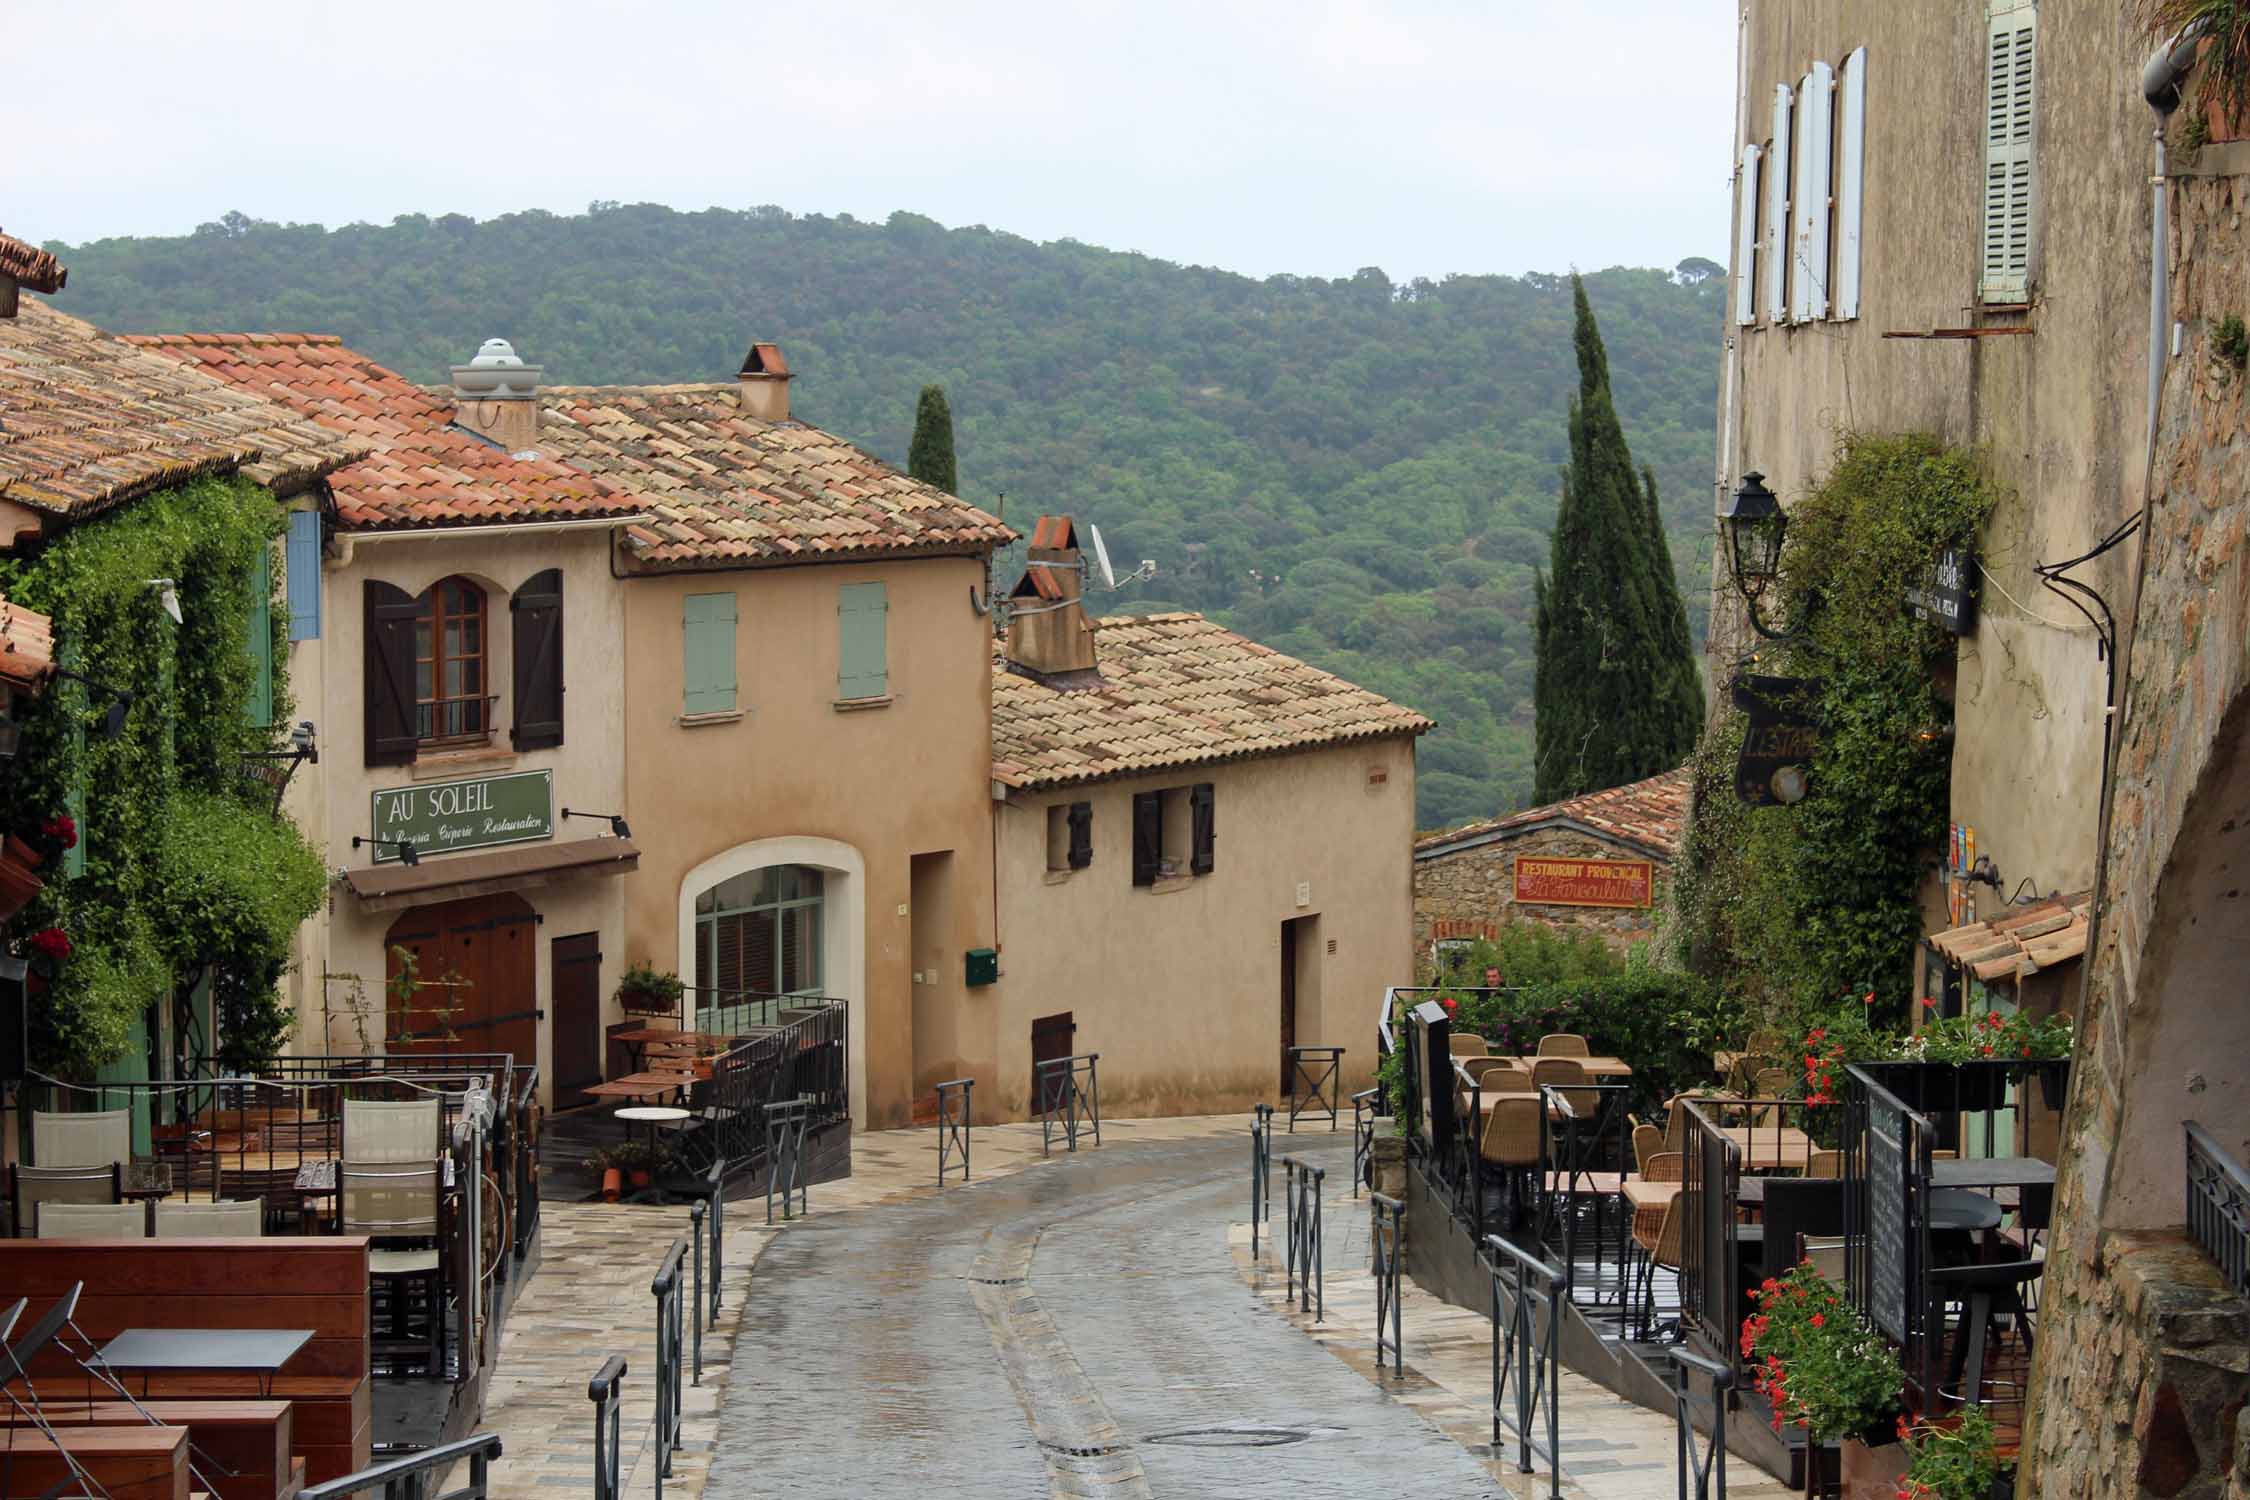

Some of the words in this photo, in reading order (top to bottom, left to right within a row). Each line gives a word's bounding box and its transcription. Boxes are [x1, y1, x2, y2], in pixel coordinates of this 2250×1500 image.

[388, 791, 414, 824] AU
[428, 783, 494, 817] SOLEIL
[482, 814, 542, 834] Restauration
[1522, 863, 1584, 877] RESTAURANT
